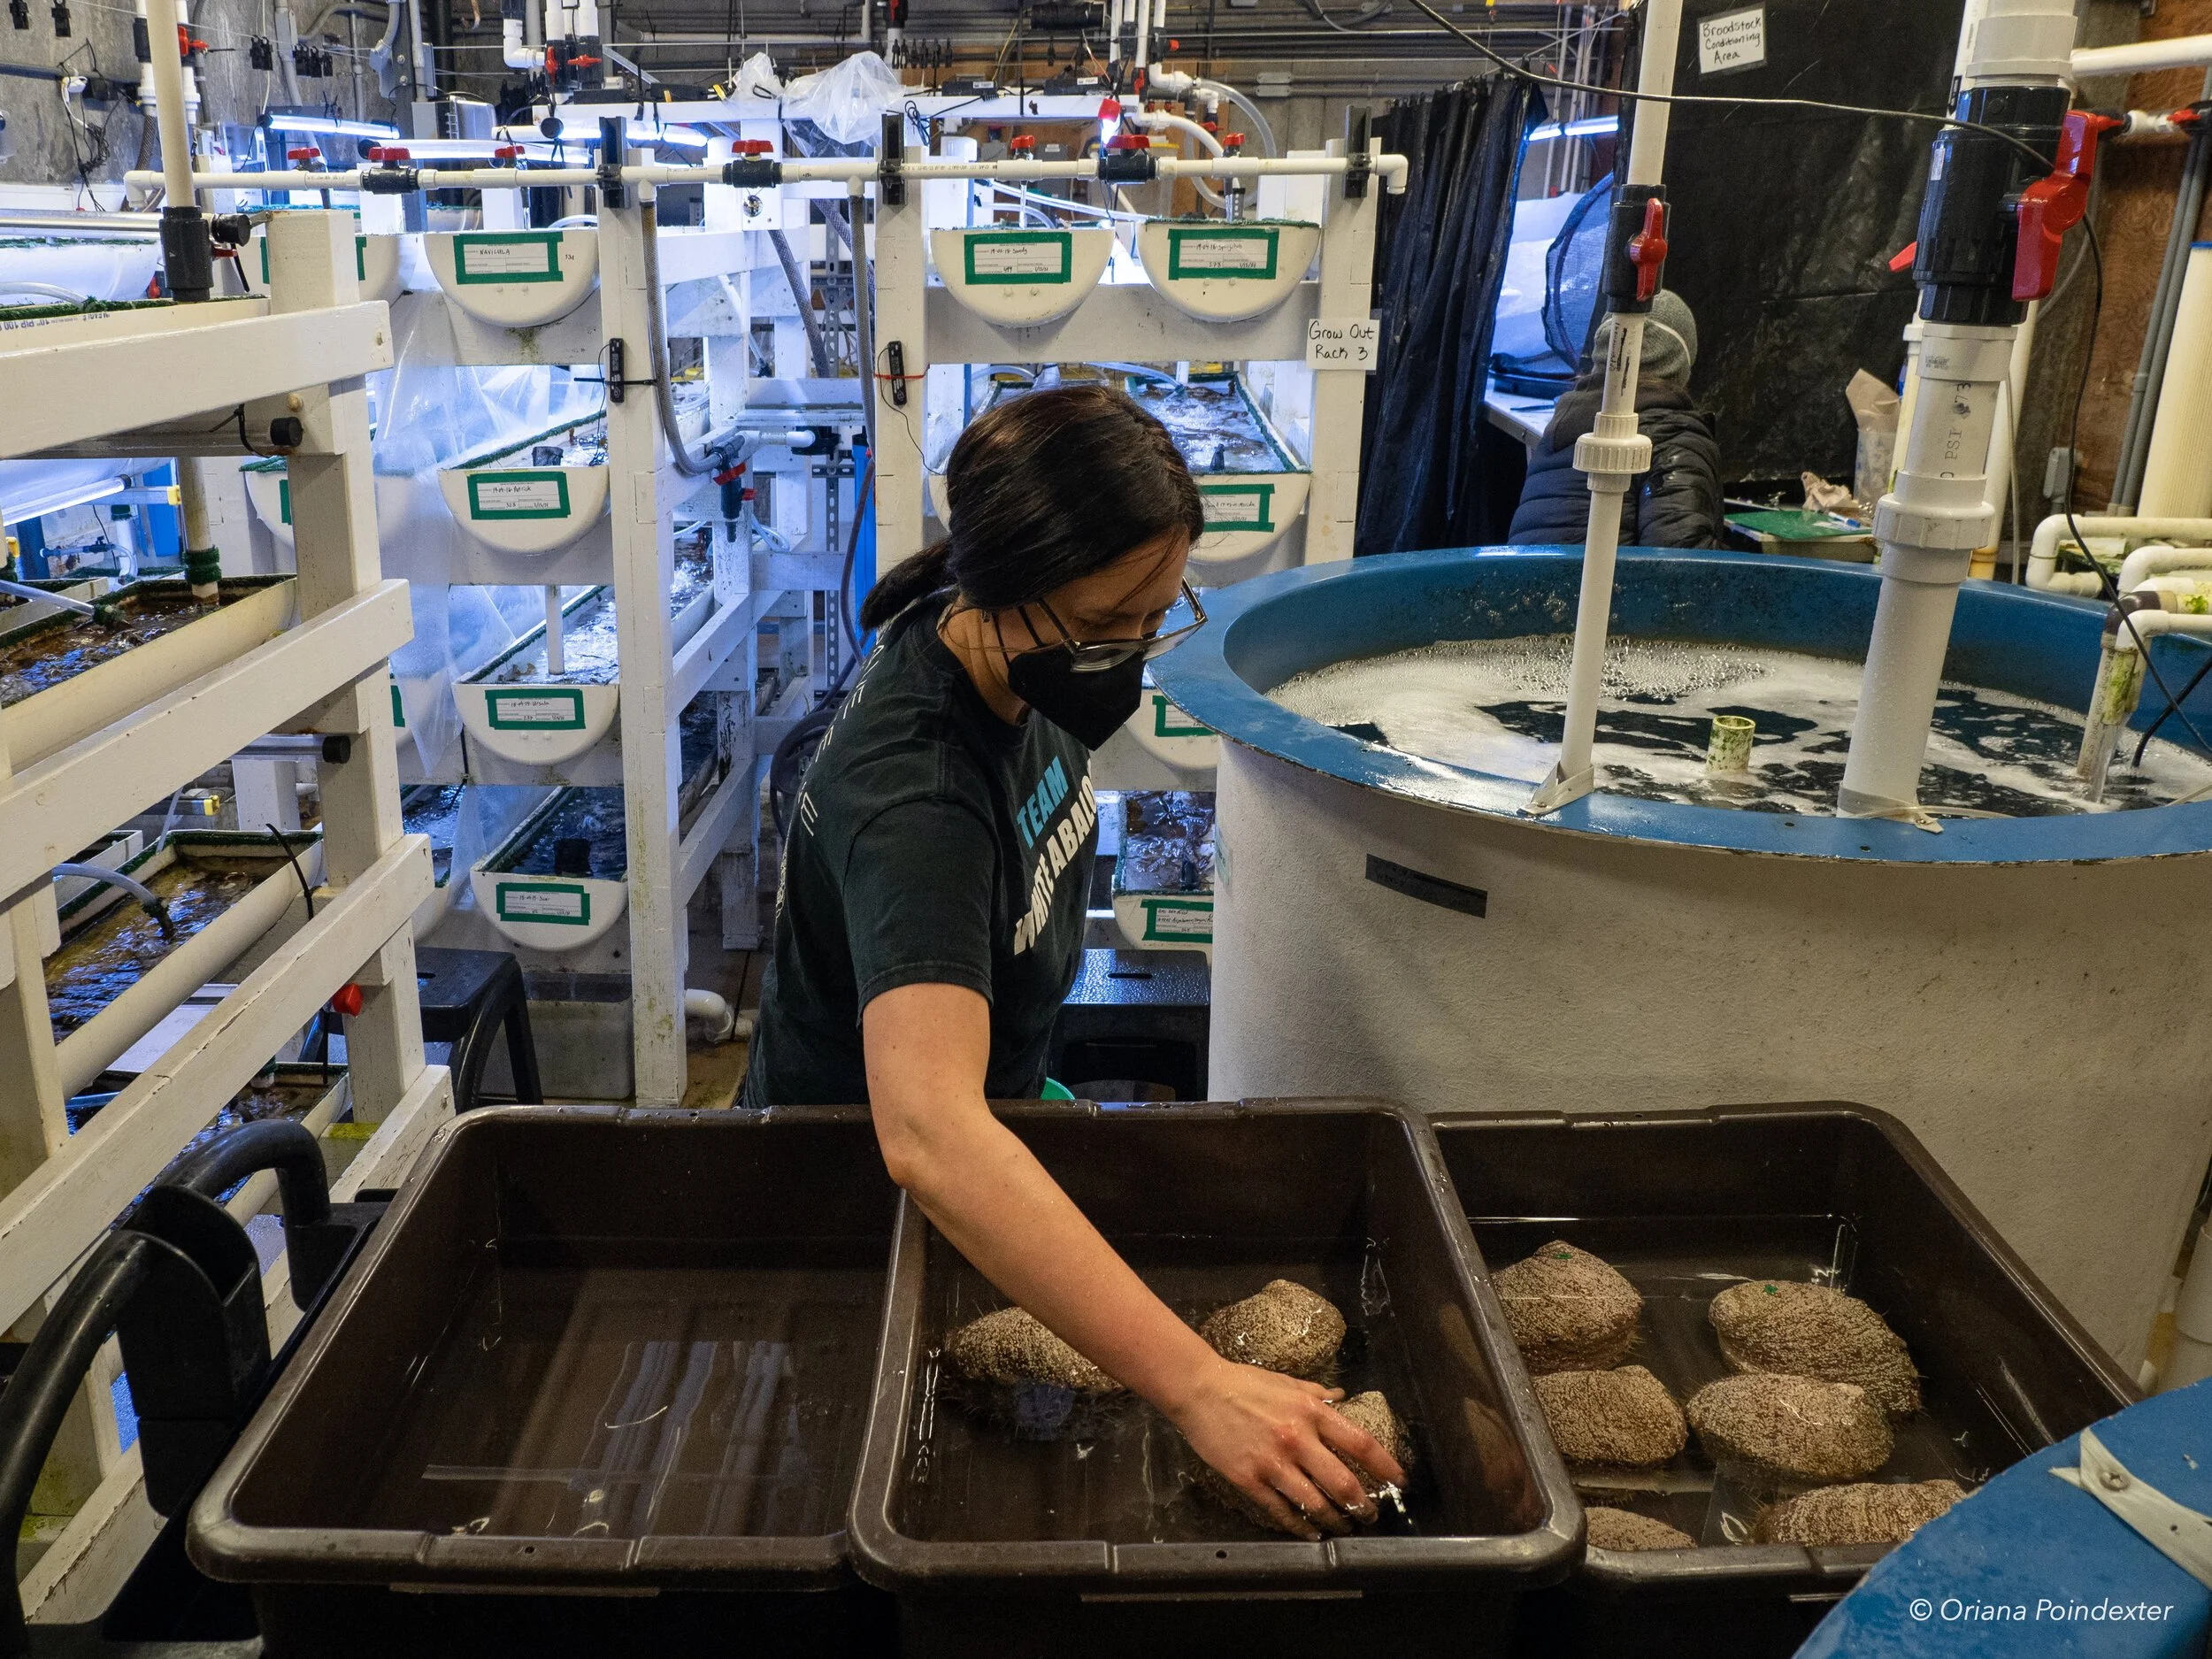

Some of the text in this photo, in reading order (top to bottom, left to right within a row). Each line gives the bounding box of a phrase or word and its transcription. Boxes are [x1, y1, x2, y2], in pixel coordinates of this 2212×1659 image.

[1702, 17, 1762, 38] Broodstock
[1705, 33, 1761, 50] Conditioning
[1714, 50, 1740, 65] Area
[1310, 320, 1375, 340] Grow Out
[1315, 344, 1369, 361] Rack 3
[1945, 429, 1962, 461] PSI
[1017, 755, 1070, 850] TEAM
[1014, 852, 1055, 956] WHITE
